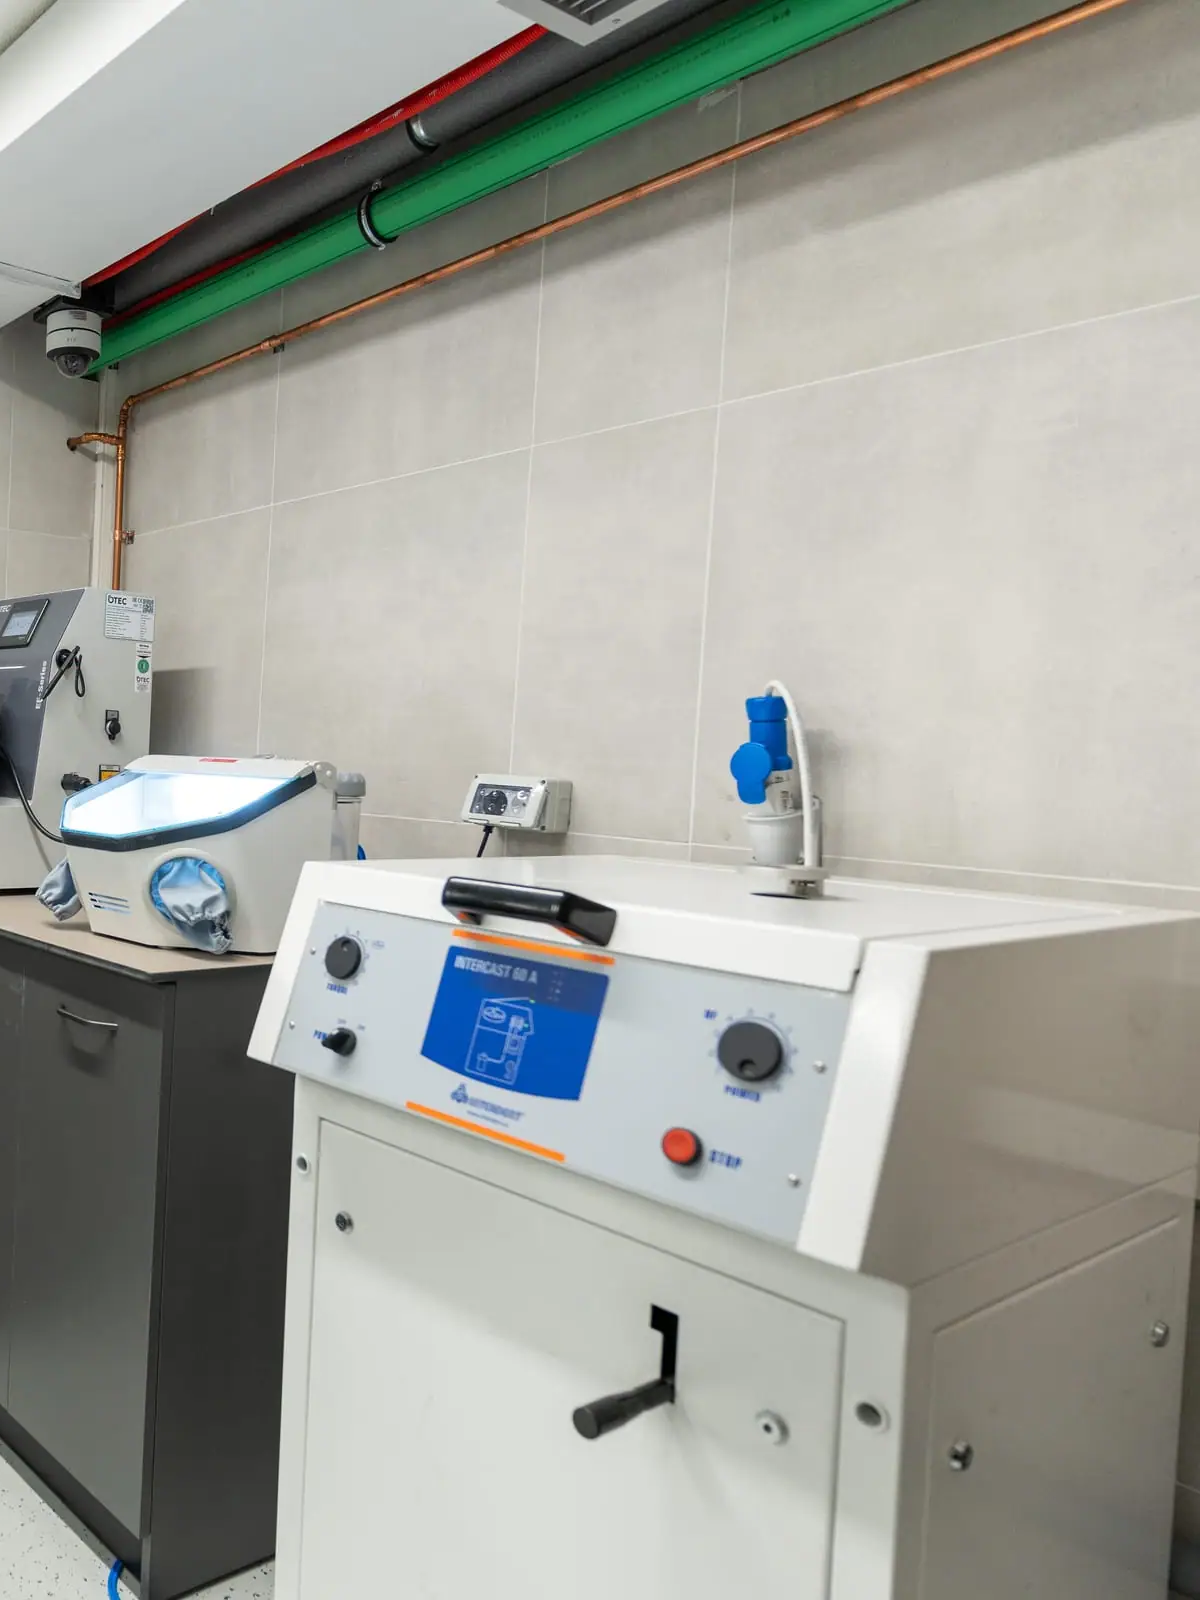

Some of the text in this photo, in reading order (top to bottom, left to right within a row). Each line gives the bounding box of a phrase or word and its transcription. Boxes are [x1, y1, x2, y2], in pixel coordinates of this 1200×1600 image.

[107, 594, 127, 605] OTEC
[453, 955, 513, 979] INTERCAST
[528, 969, 538, 984] A
[709, 1148, 743, 1169] STOP
